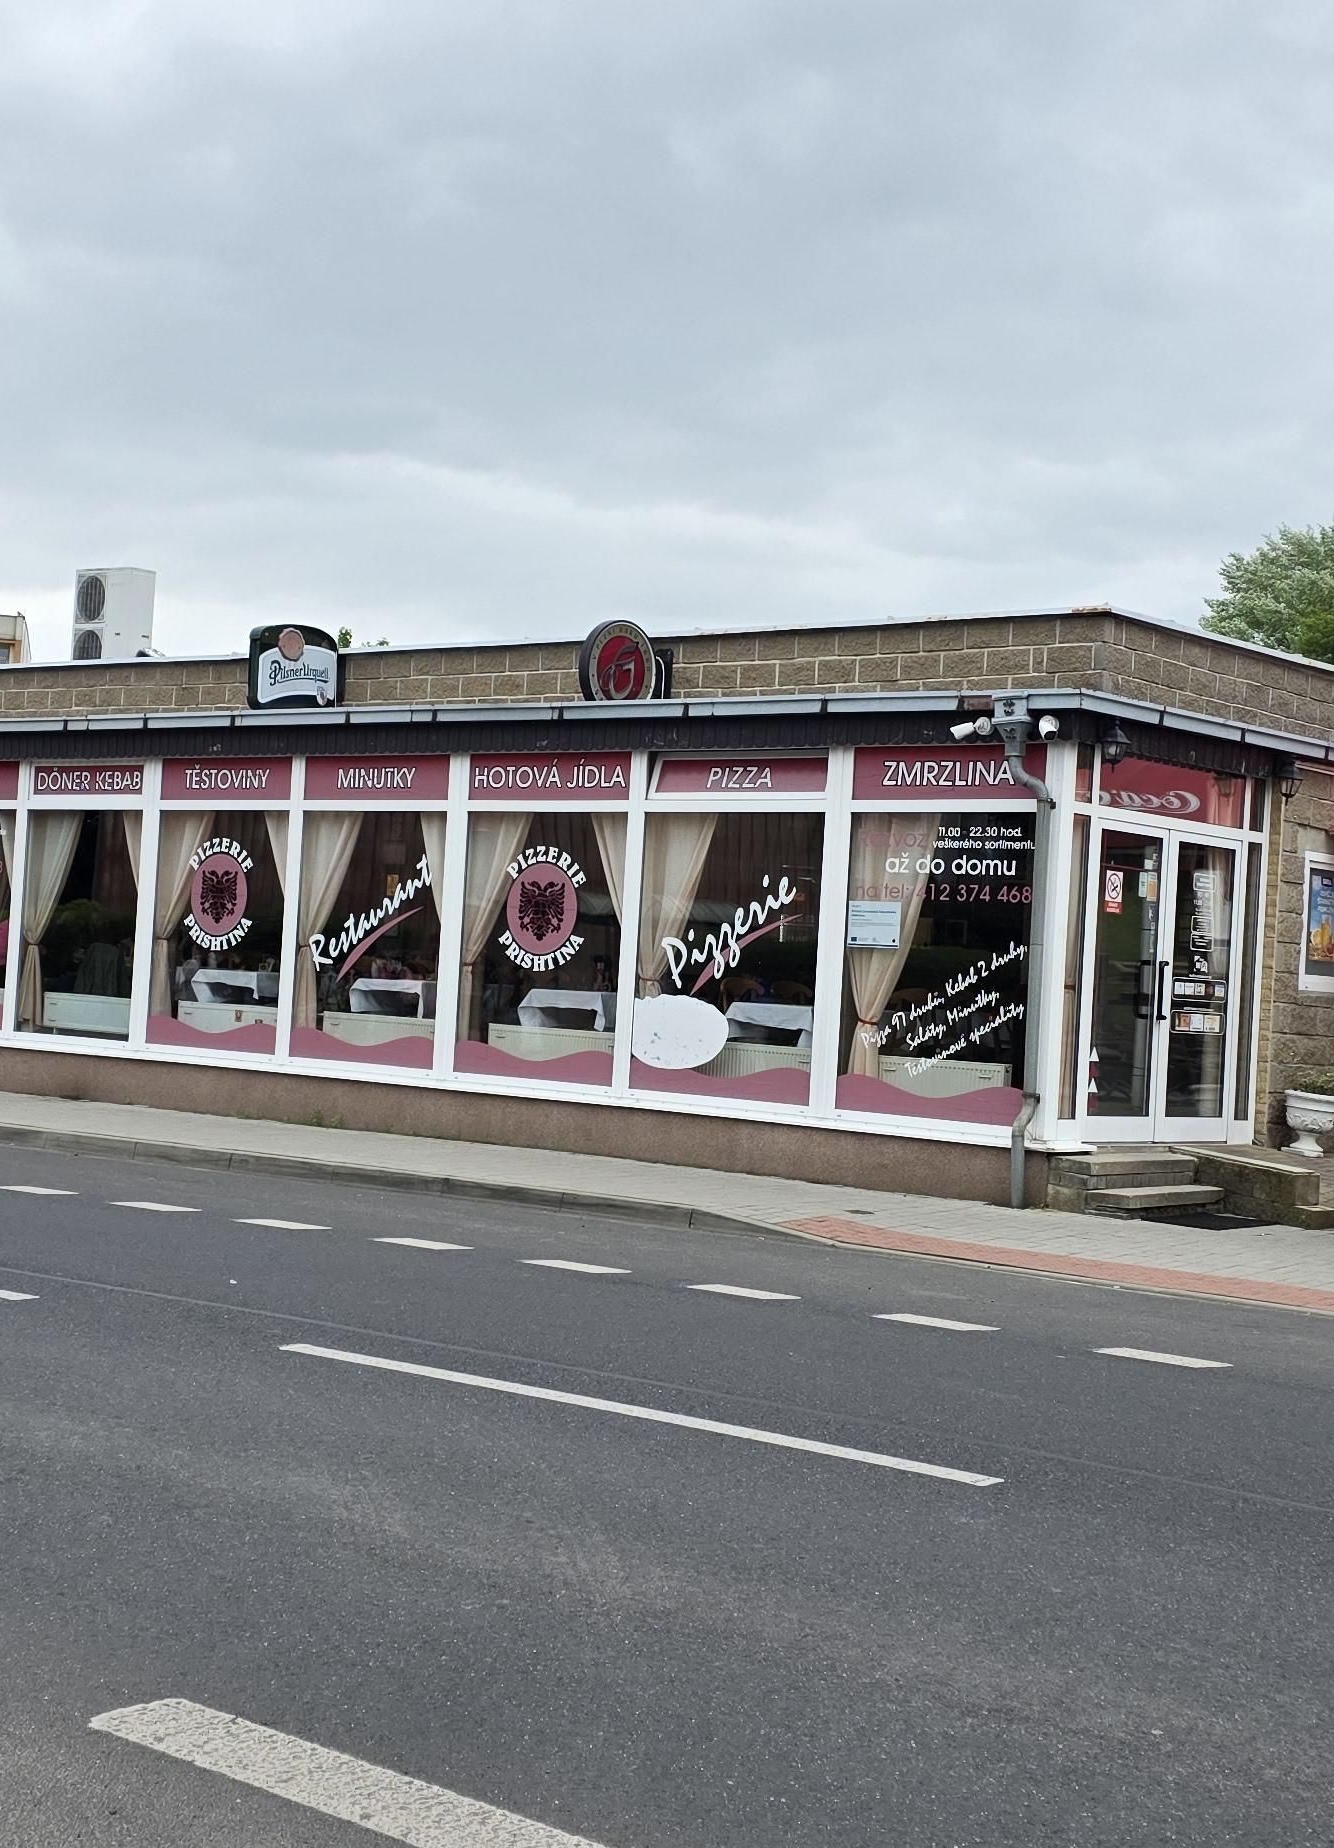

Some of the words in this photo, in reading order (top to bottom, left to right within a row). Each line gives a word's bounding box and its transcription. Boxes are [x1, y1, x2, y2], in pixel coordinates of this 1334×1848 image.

[268, 659, 303, 687] Pilsner
[302, 661, 330, 684] Urquell
[36, 767, 91, 791] DÖNER
[95, 771, 142, 791] KEBAB
[184, 764, 270, 790] TĚSTOVINY
[336, 766, 416, 790] MINUTKY
[473, 758, 562, 789] HOTOVÁ
[565, 758, 627, 789] JÍDLA
[705, 766, 773, 789] PIZZA
[882, 759, 1016, 787] ZMRZLINA
[932, 838, 983, 849] veškerého
[984, 839, 1036, 850] sortimentu
[938, 826, 961, 837] 11.00
[969, 826, 998, 837] 22.30
[188, 837, 254, 873] PIZZERIE
[506, 845, 587, 889] PIZZERIE
[885, 852, 910, 874] až
[916, 854, 945, 875] do
[951, 854, 1017, 876] domu
[856, 885, 878, 898] na
[883, 883, 911, 899] tel:
[913, 883, 950, 901] 412
[956, 884, 991, 902] 374
[997, 885, 1033, 904] 468
[308, 853, 433, 972] Restaurant
[183, 913, 253, 951] PRISHTINA
[661, 874, 797, 990] Pizzerie
[497, 929, 585, 972] PRISHTINA
[860, 1025, 892, 1049] Pizza
[945, 965, 979, 997] Kebab
[977, 960, 990, 978] 2
[990, 940, 1028, 971] druhy,
